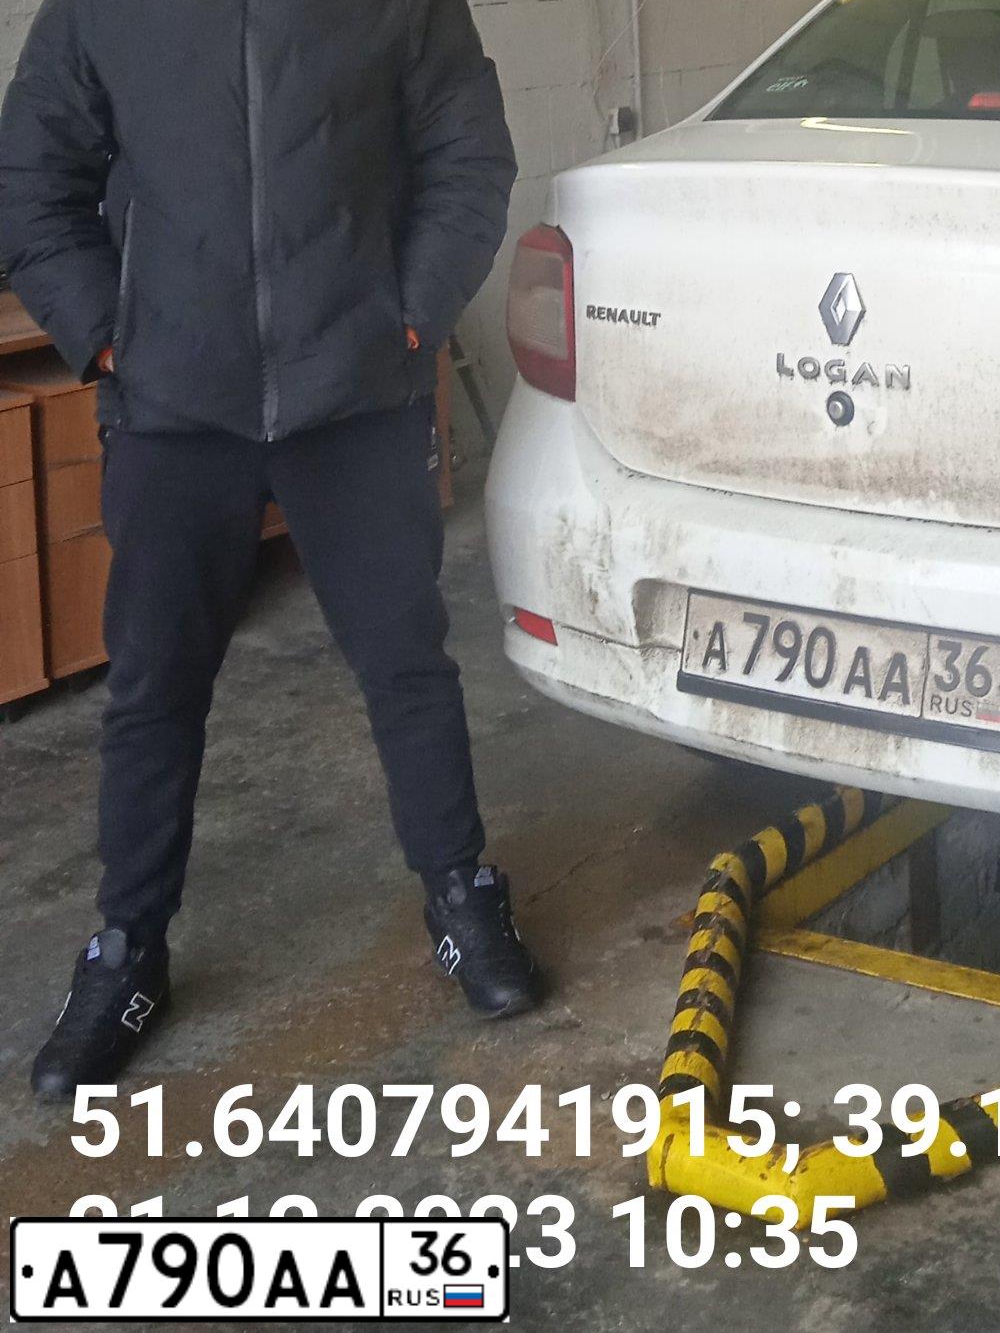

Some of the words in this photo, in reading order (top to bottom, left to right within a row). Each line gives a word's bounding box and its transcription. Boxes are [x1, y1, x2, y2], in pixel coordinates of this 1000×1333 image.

[586, 304, 661, 326] RENAULT
[776, 352, 911, 391] LOGAN
[701, 612, 911, 705] A790AA
[934, 640, 993, 698] 36
[929, 694, 973, 717] RUS
